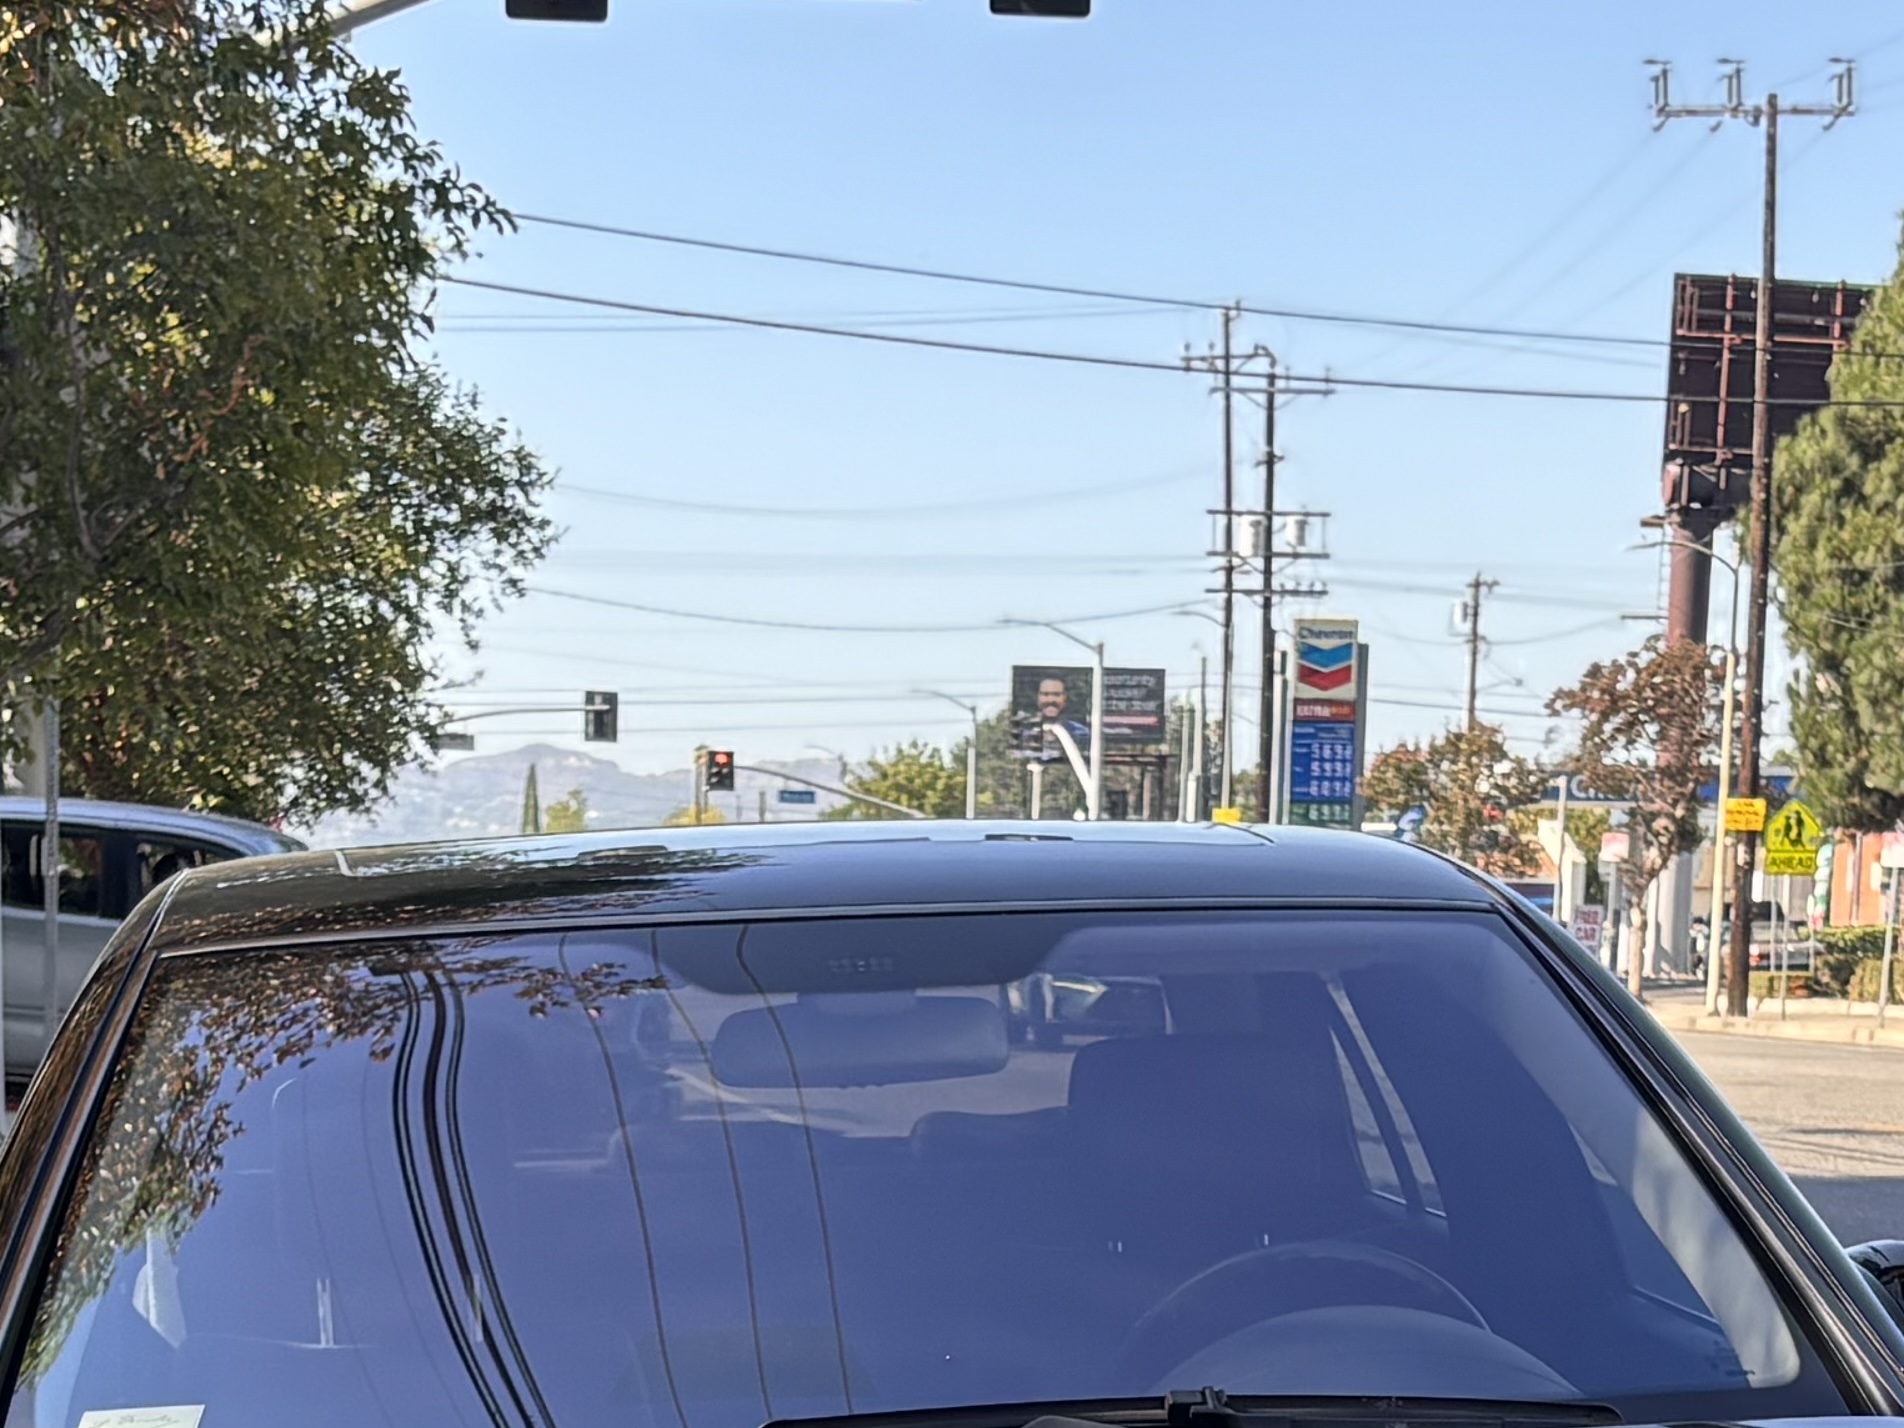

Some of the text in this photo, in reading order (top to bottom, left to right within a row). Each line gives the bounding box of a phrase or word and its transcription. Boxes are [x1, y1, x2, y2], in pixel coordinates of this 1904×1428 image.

[1298, 626, 1354, 640] Chevron
[1769, 855, 1813, 869] AHEAD
[1576, 926, 1597, 942] CAR
